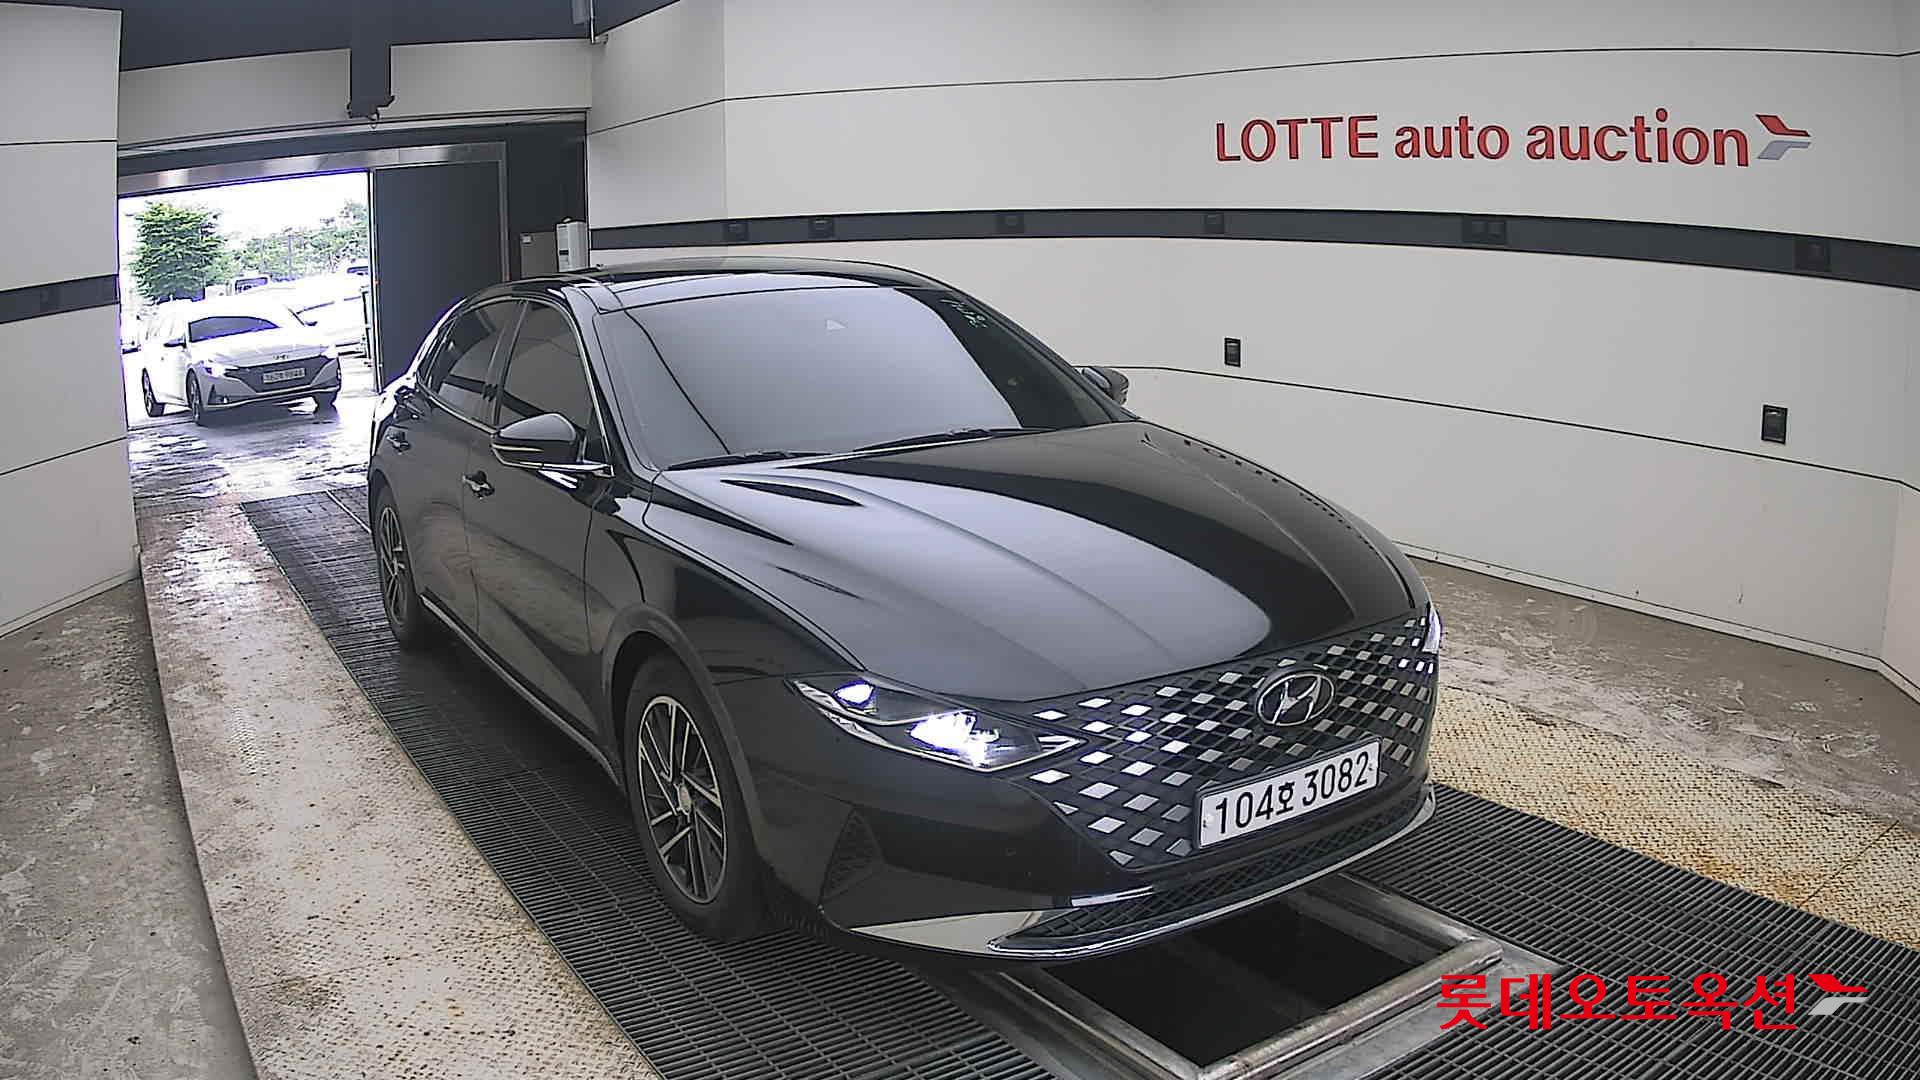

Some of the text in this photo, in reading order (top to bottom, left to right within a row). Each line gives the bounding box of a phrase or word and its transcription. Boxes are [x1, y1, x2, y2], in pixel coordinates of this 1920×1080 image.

[1216, 109, 1751, 167] LOTTE auto auction
[1215, 751, 1369, 834] 104호 3082
